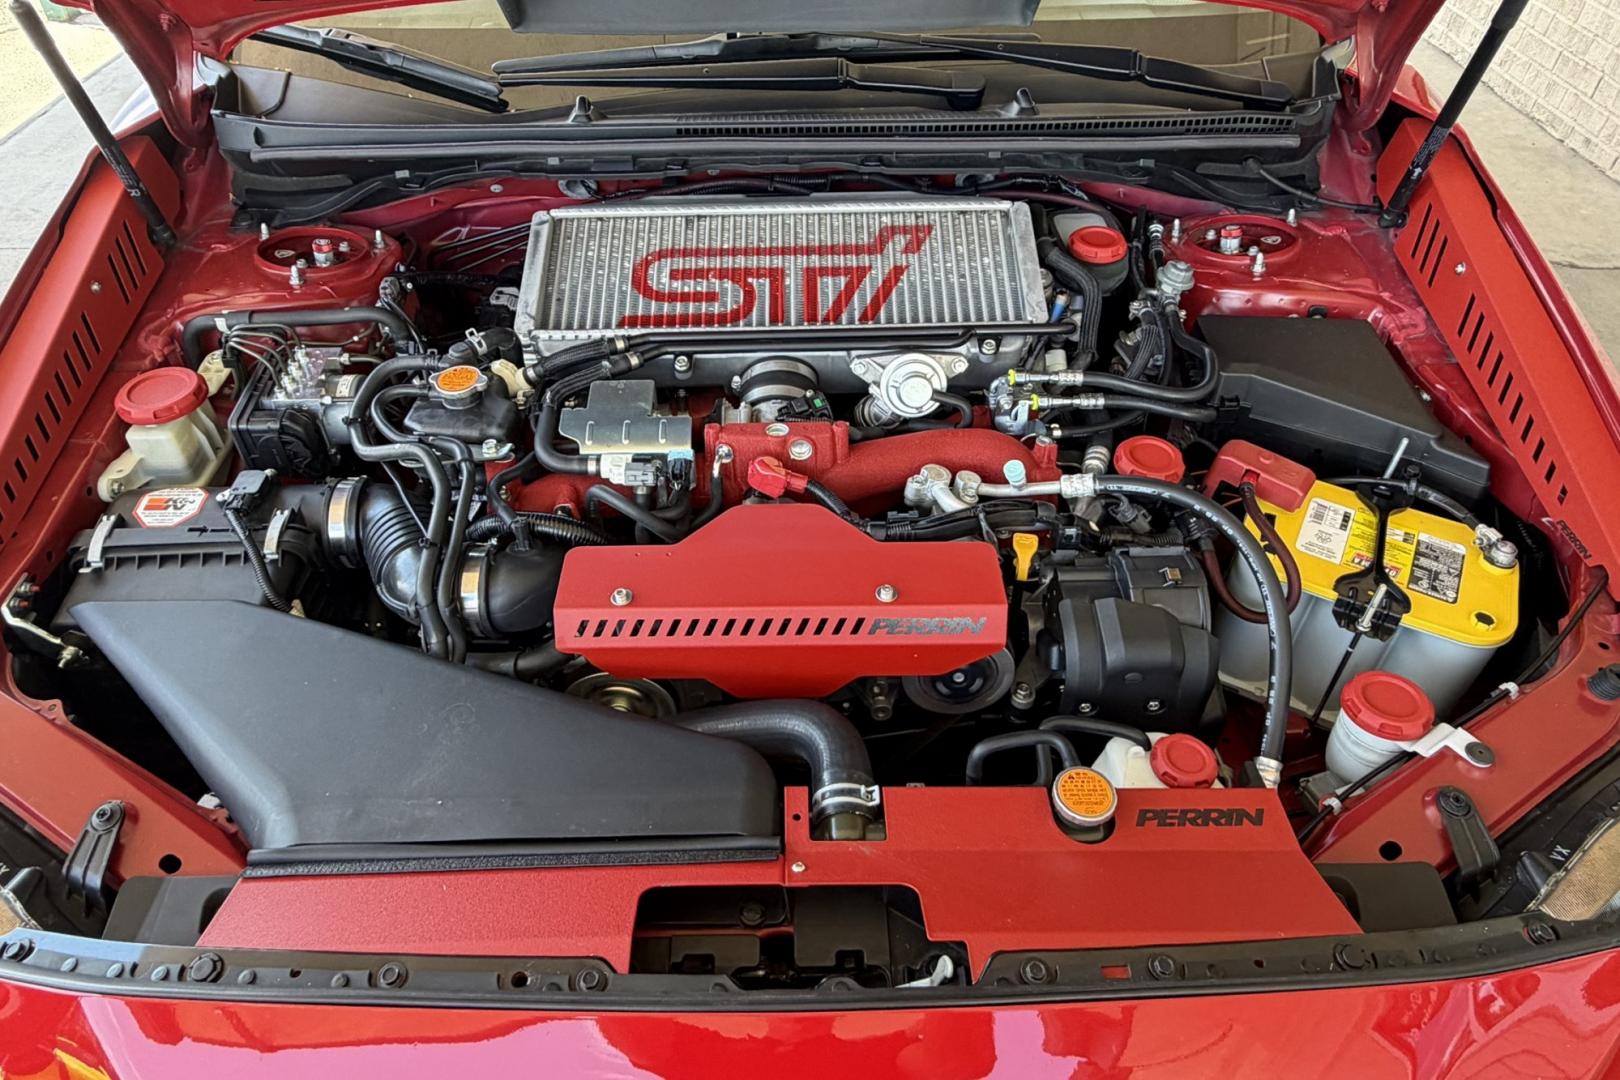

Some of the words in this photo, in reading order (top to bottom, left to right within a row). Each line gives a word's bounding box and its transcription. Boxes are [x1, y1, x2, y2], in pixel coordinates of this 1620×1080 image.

[1556, 519, 1593, 560] PERRIN
[868, 617, 987, 635] PERRIN
[1136, 808, 1265, 827] PERRIN
